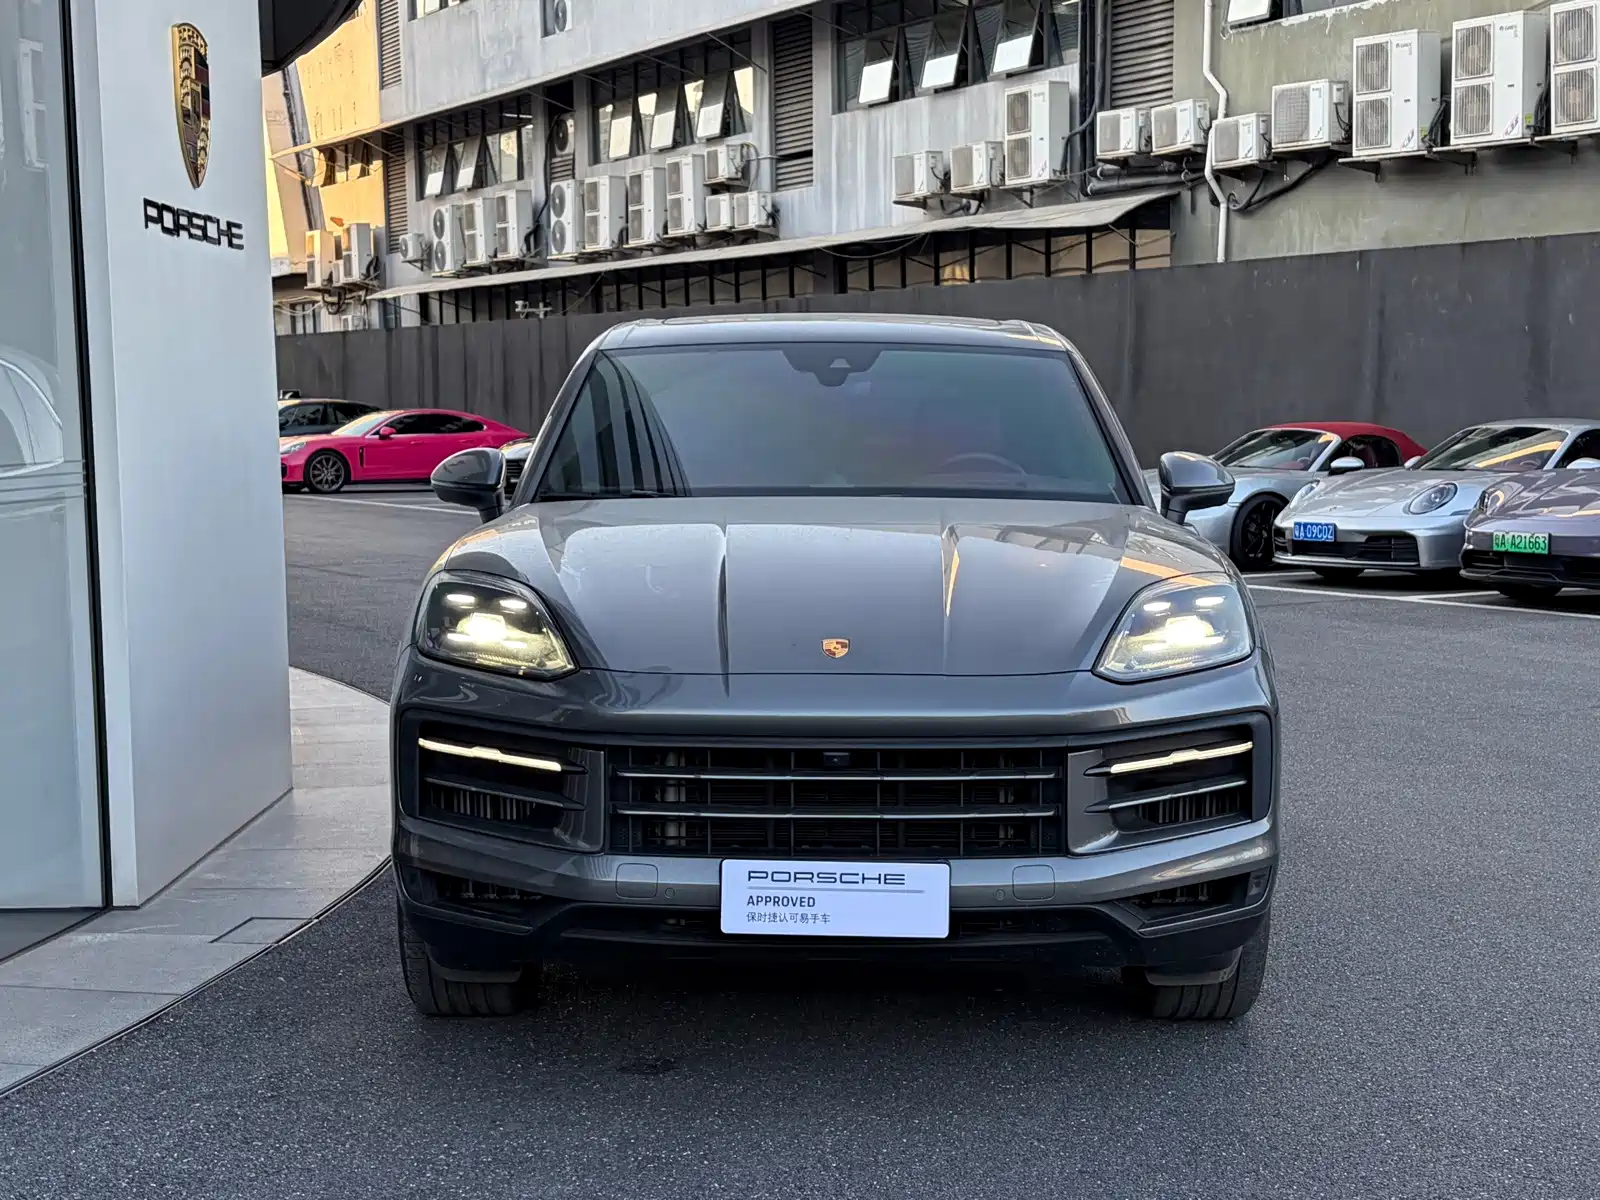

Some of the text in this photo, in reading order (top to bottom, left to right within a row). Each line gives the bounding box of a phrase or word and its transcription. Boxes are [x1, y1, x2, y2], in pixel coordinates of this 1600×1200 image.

[143, 197, 244, 250] PORSCHE
[747, 870, 906, 886] PORSCHE
[746, 895, 816, 908] APPROVED
[746, 911, 831, 924] 保时捷认可易手车
